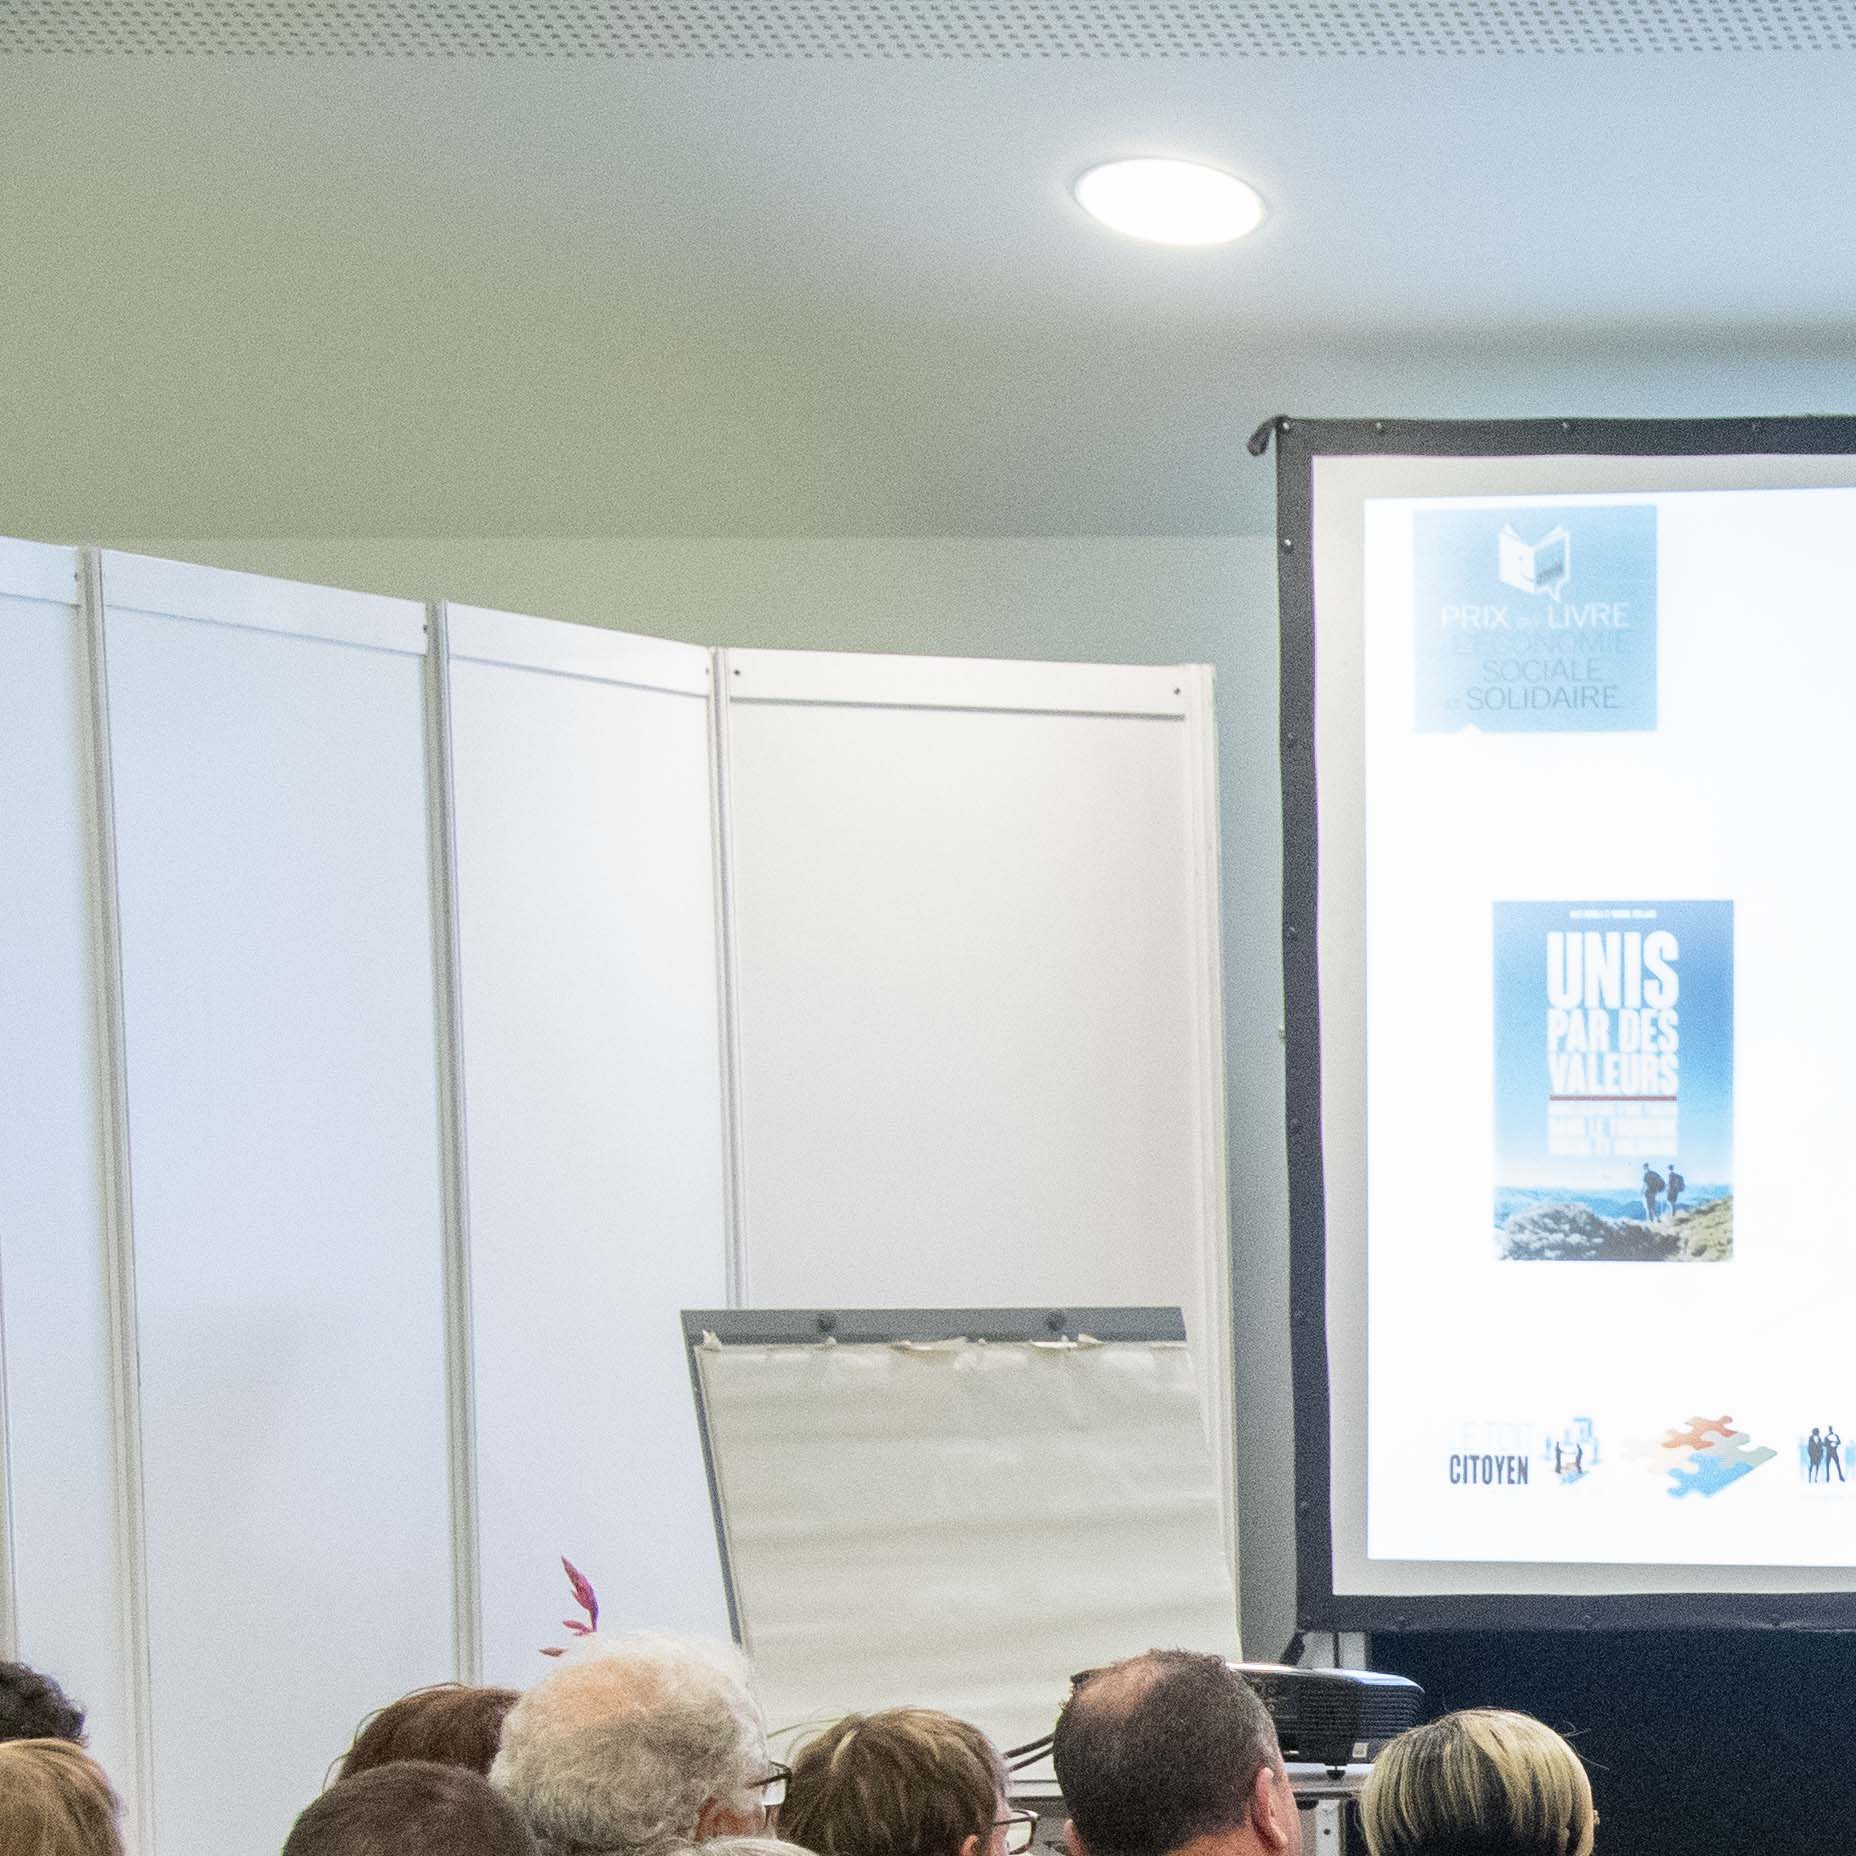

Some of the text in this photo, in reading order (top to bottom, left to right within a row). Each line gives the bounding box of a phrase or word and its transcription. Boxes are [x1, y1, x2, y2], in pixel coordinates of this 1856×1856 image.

[1441, 604, 1511, 630] PRIX
[1548, 602, 1631, 629] LIVRE
[1483, 658, 1605, 683] SOCIALE
[1466, 684, 1620, 711] SOLIDAIRE
[1547, 930, 1680, 1010] UNIS
[1547, 1008, 1680, 1054] PAR DES
[1547, 1053, 1680, 1096] VALEURS
[1449, 1454, 1530, 1486] CITOYEN
